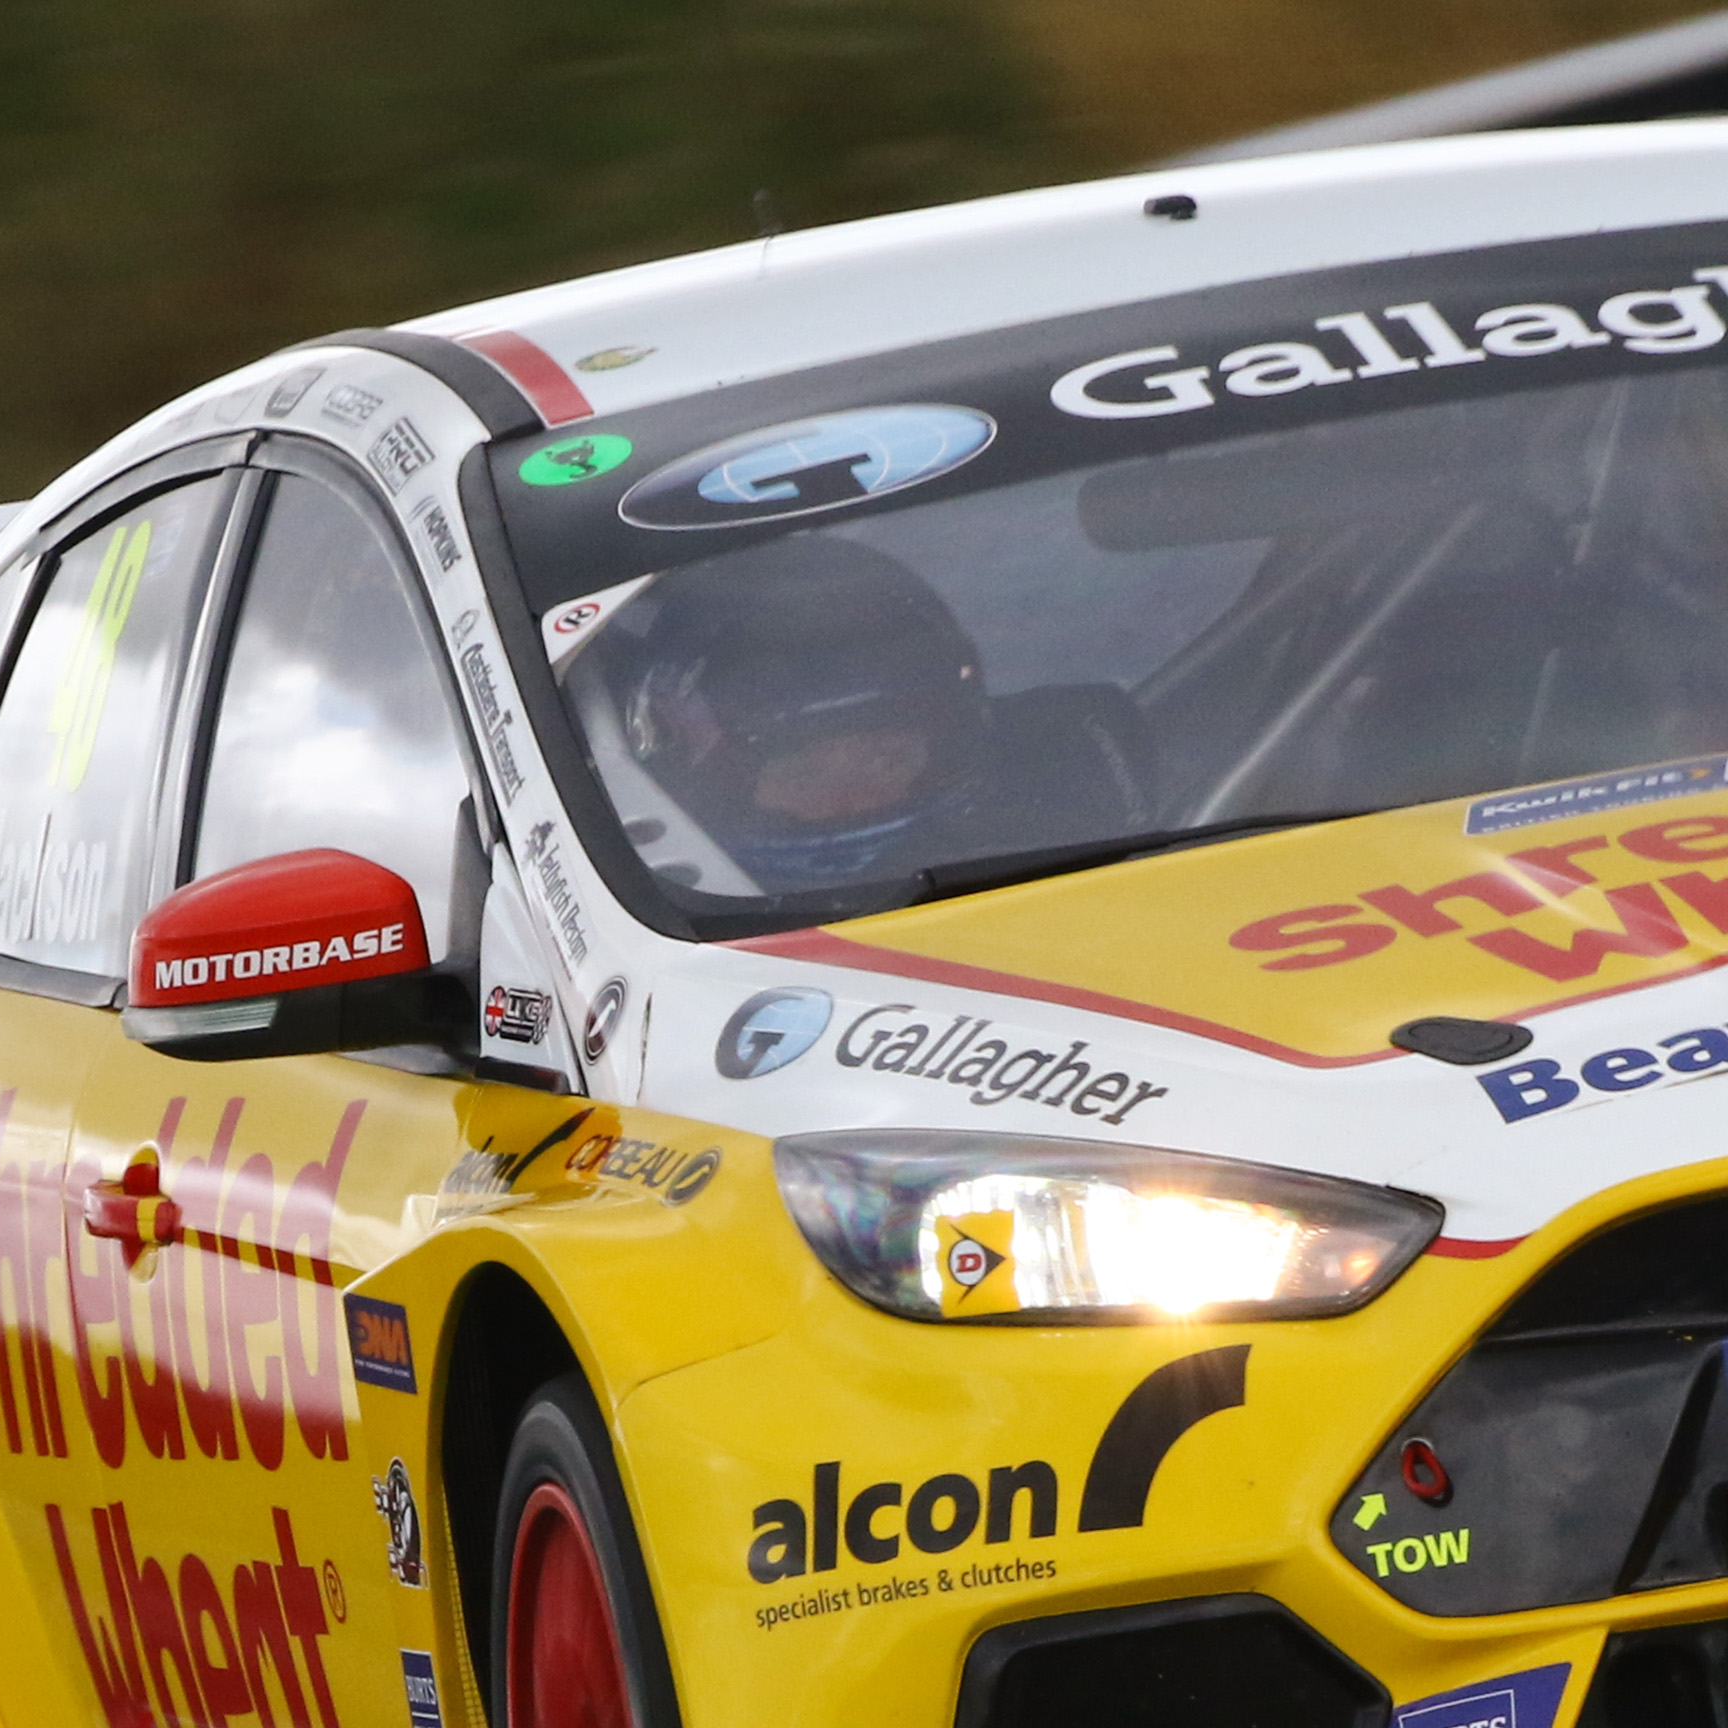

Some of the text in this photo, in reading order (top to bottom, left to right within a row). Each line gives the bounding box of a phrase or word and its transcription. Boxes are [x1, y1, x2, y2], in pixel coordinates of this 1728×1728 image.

[154, 922, 405, 991] MOTORBASE
[834, 1003, 1170, 1127] Gallagher
[746, 1459, 1060, 1585] alcon
[1367, 1528, 1470, 1578] TOW
[755, 1557, 1058, 1631] specialist brakes & clutches
